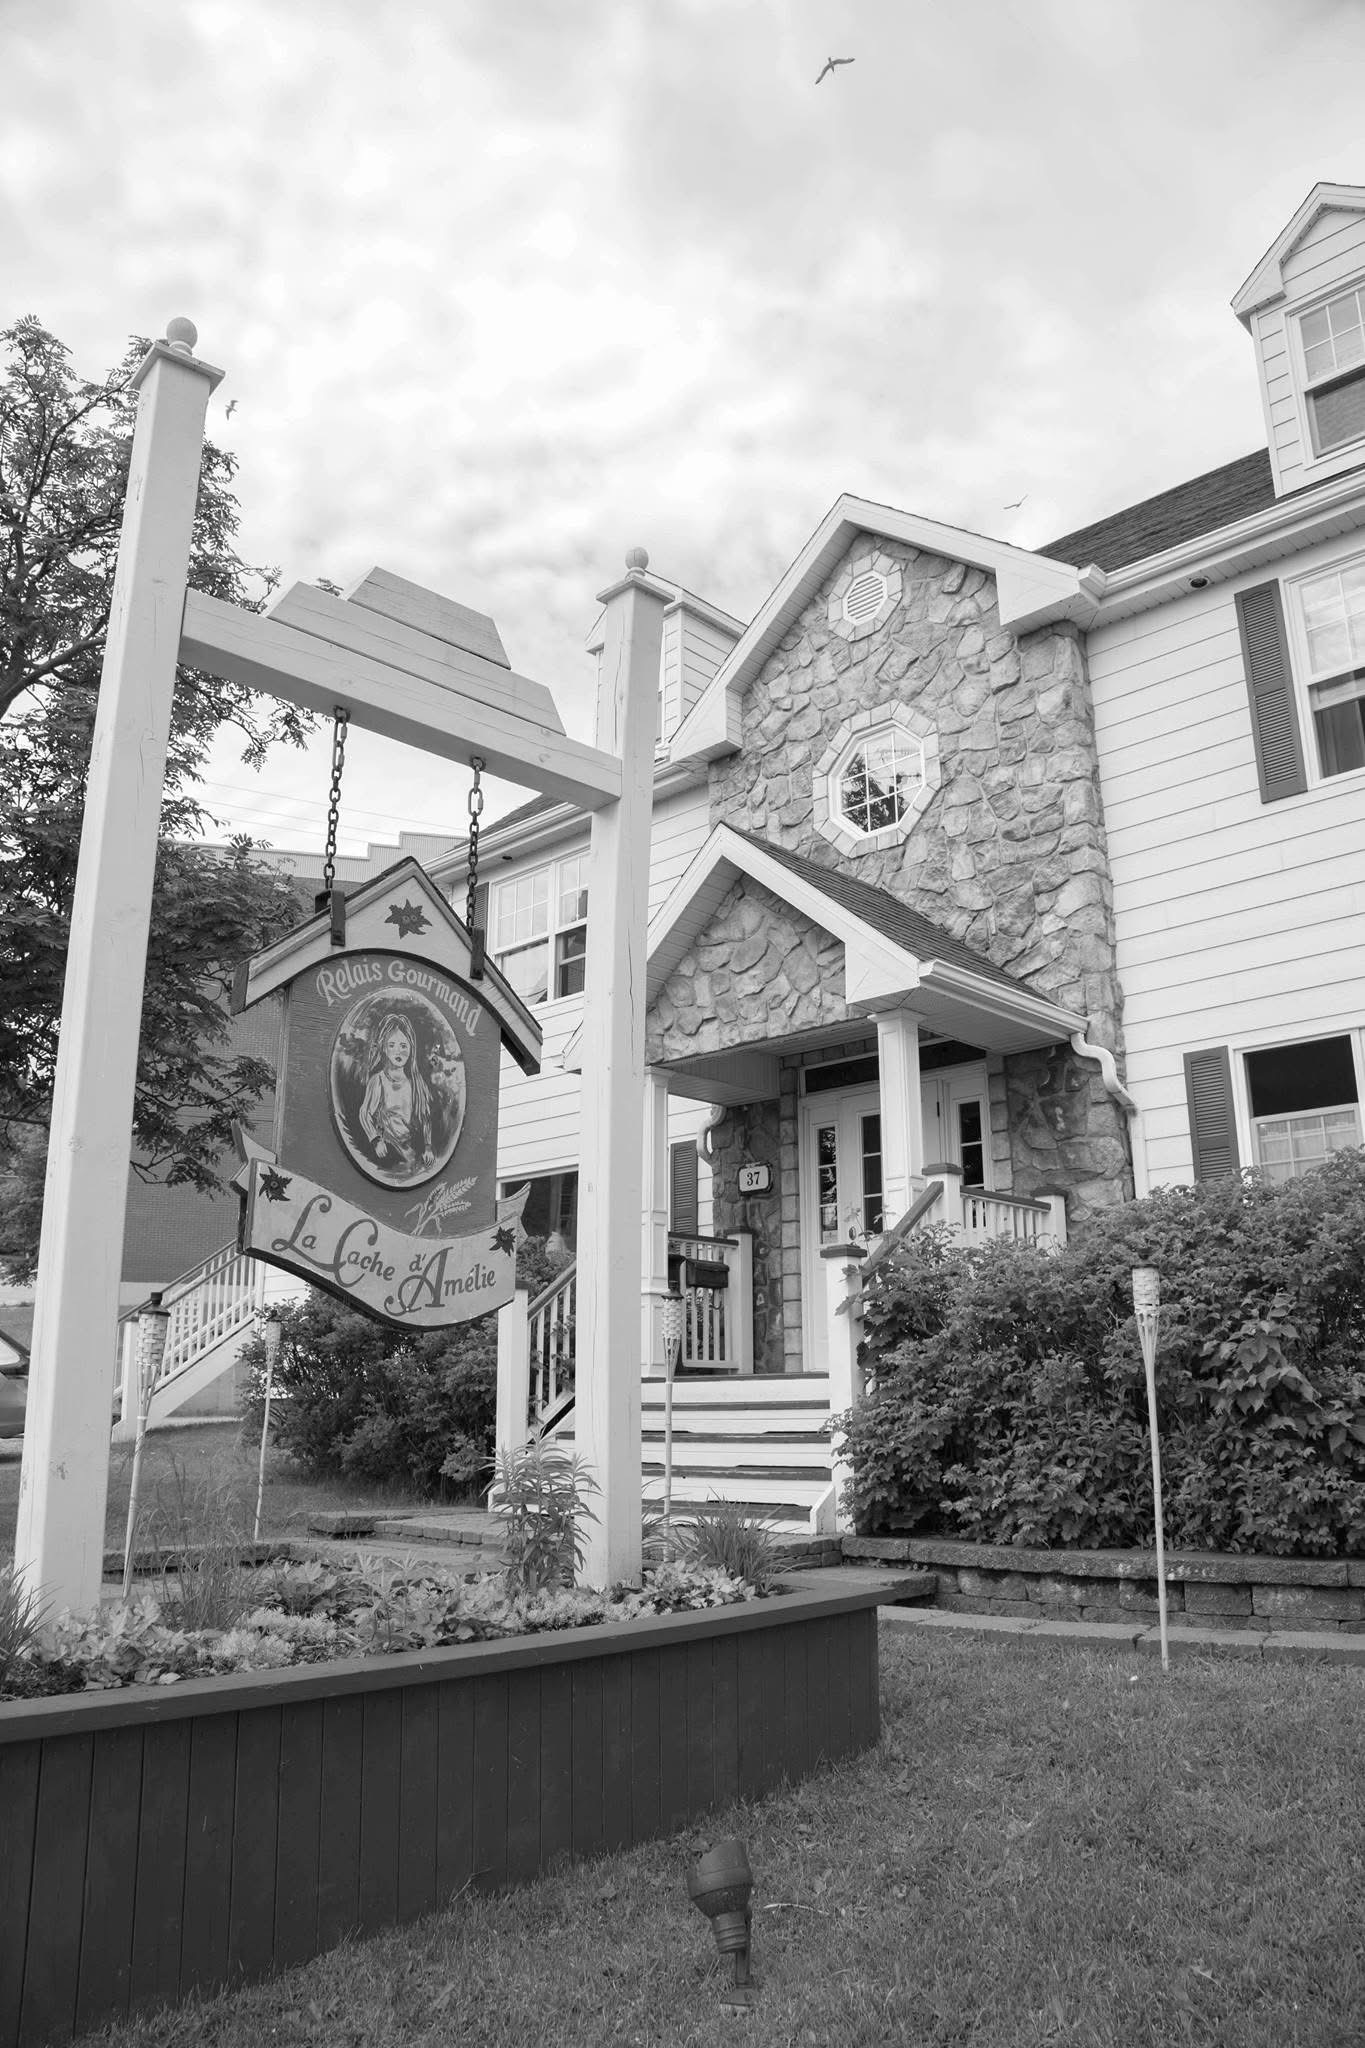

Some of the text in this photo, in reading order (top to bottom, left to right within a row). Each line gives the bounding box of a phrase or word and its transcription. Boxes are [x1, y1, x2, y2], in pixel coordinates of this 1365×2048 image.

[316, 957, 482, 1037] Relais Gourmand
[746, 1171, 760, 1186] 37
[271, 1194, 497, 1316] La Cache d'Amélie
